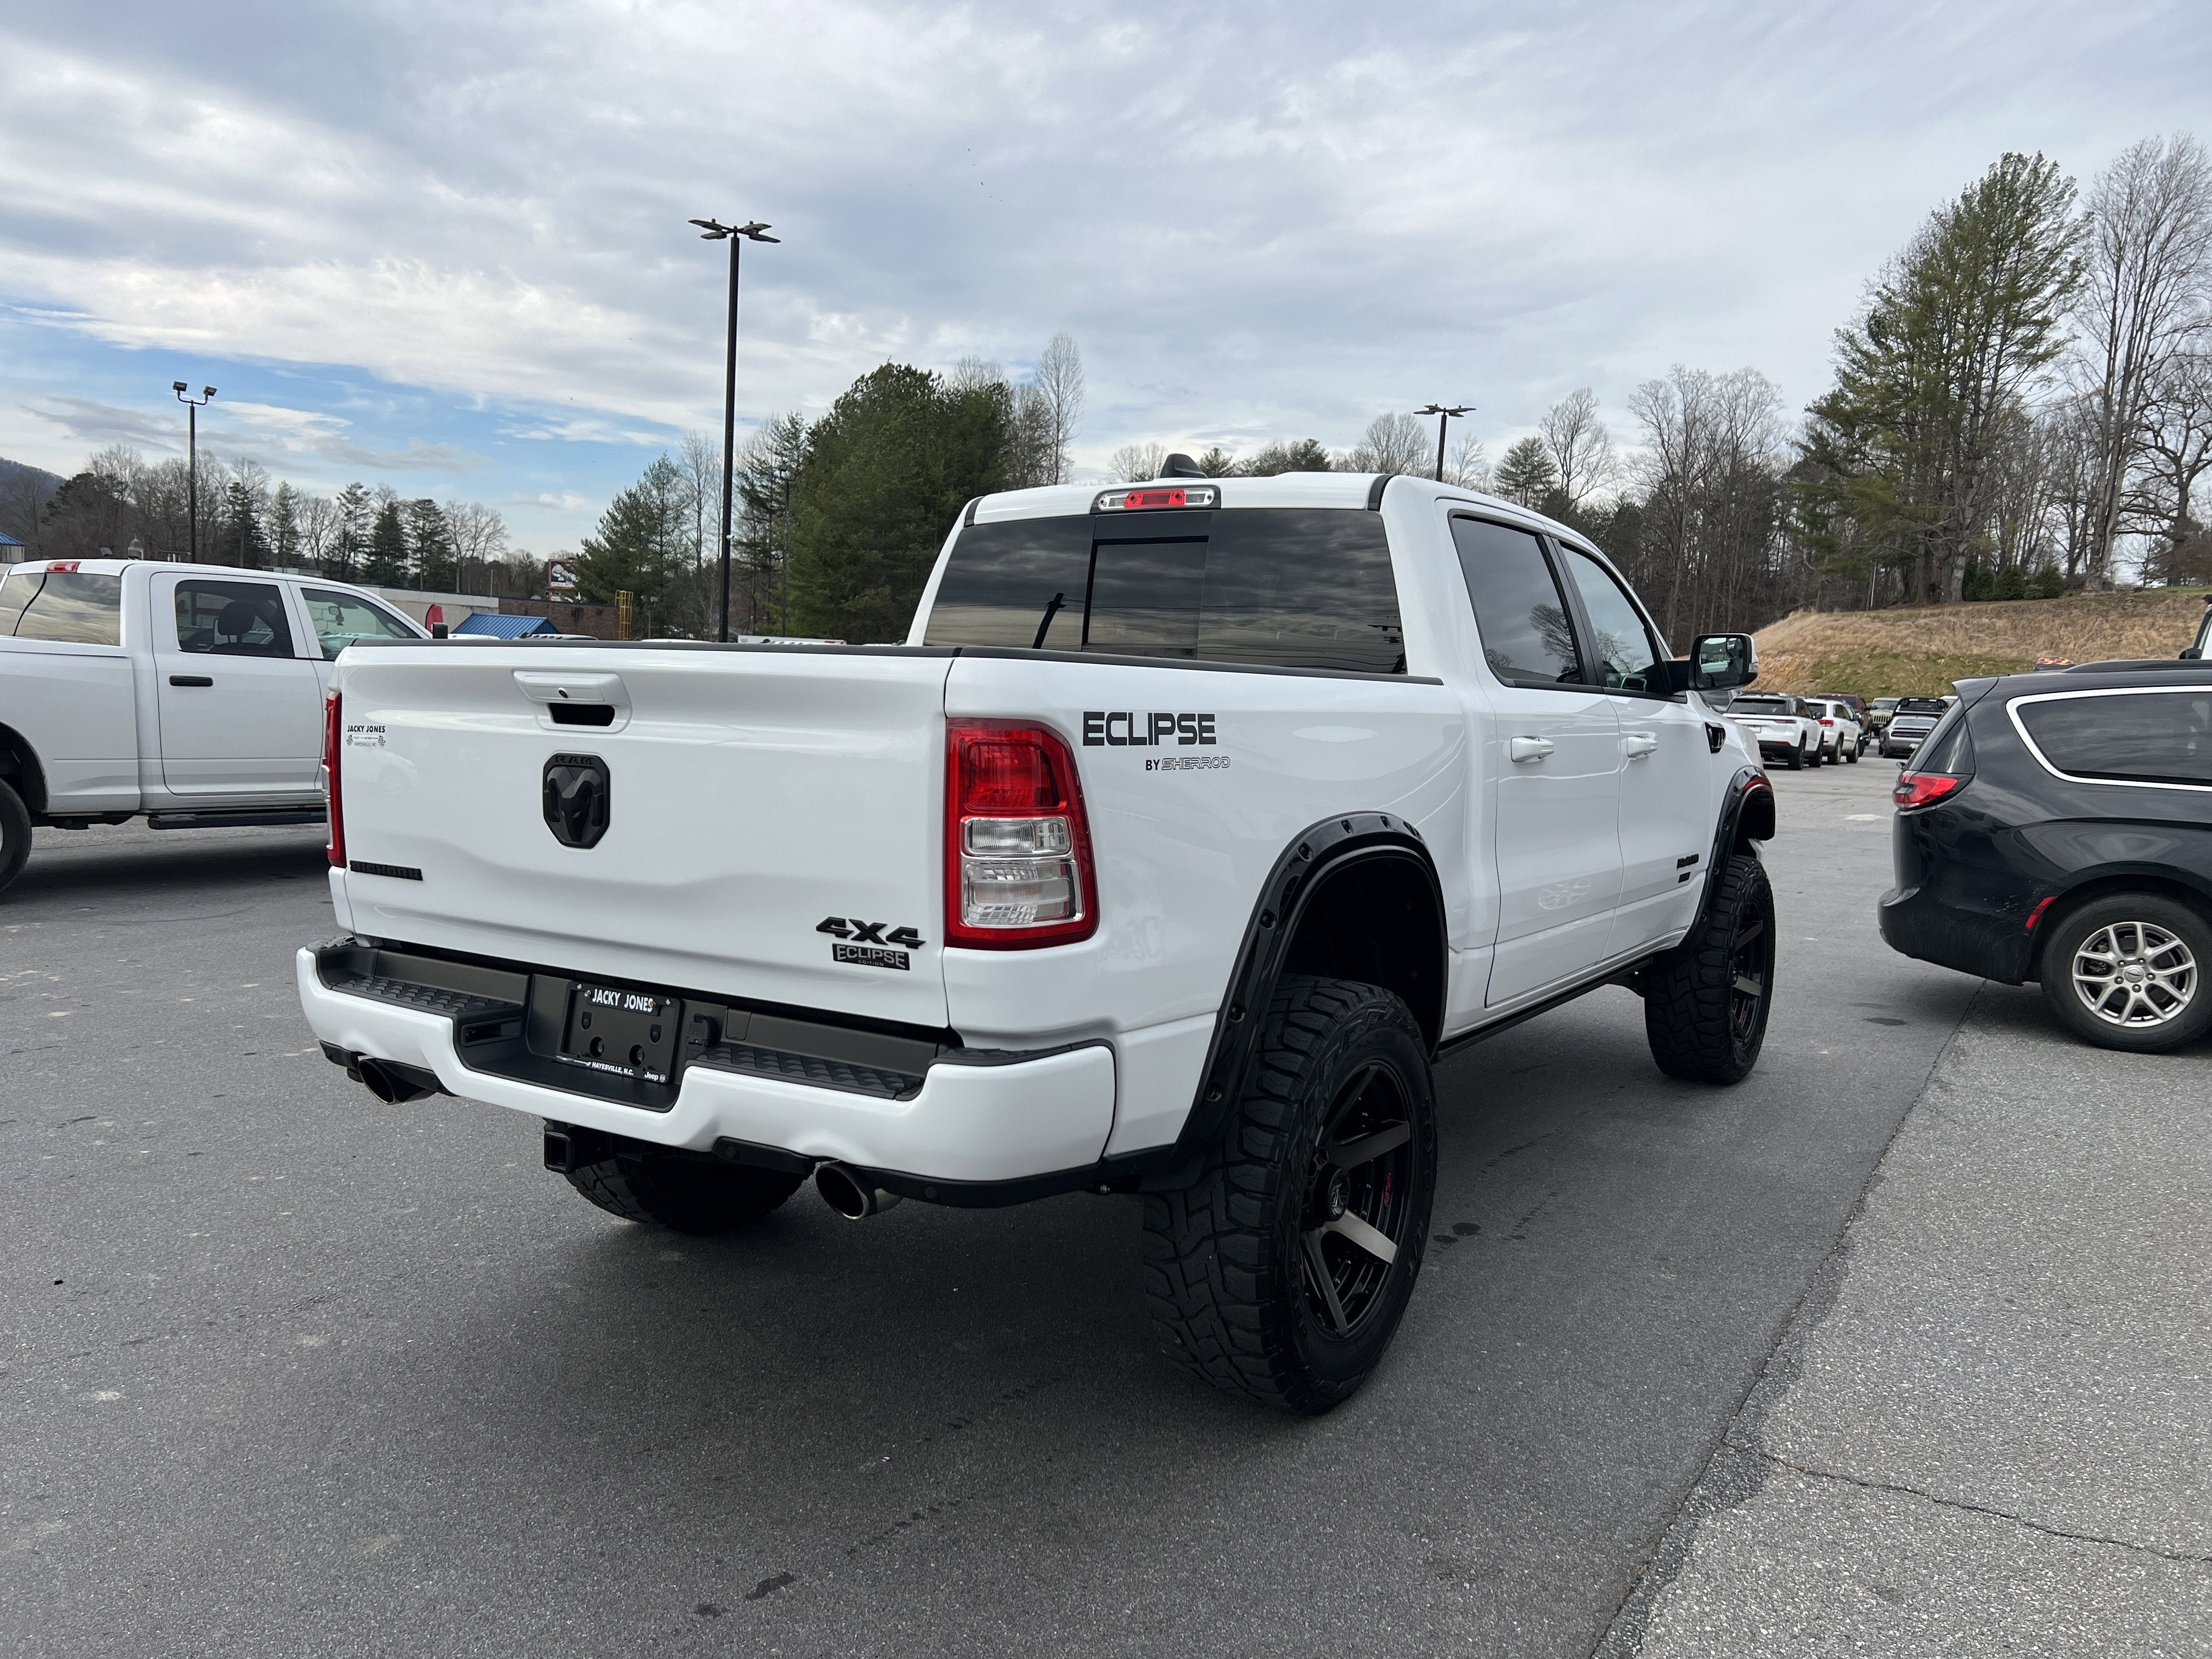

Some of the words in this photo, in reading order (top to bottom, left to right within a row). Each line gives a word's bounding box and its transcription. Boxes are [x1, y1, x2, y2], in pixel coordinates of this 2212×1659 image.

[1082, 711, 1217, 746] ECLIPSE
[555, 755, 595, 765] RAM
[1146, 759, 1160, 771] BY
[1161, 757, 1231, 770] SHERROD
[837, 945, 906, 969] ECLIPSE
[592, 989, 621, 1006] JACKY
[624, 994, 653, 1012] JONES
[591, 1062, 623, 1074] HAYESVILLE,
[644, 1071, 659, 1081] Jeep
